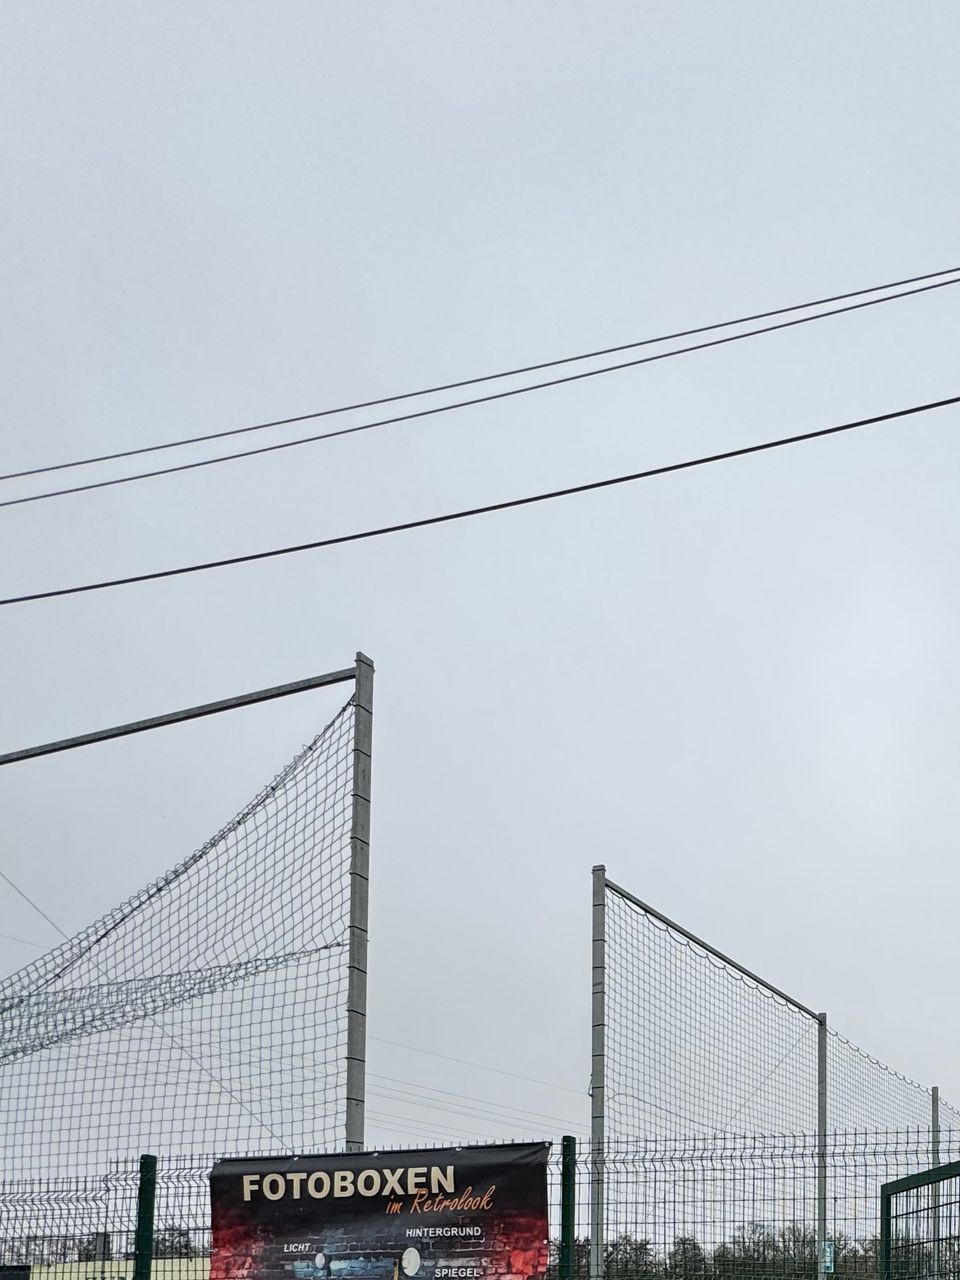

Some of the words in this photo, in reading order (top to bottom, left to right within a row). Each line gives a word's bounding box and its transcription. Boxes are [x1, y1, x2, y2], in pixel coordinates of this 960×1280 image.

[242, 1165, 455, 1202] FOTOBOXEN
[385, 1195, 402, 1214] im
[410, 1185, 496, 1214] Retrolook
[406, 1226, 482, 1238] HINTERGRUND
[283, 1243, 312, 1253] LICHT
[435, 1268, 484, 1278] SPIEGEL-
